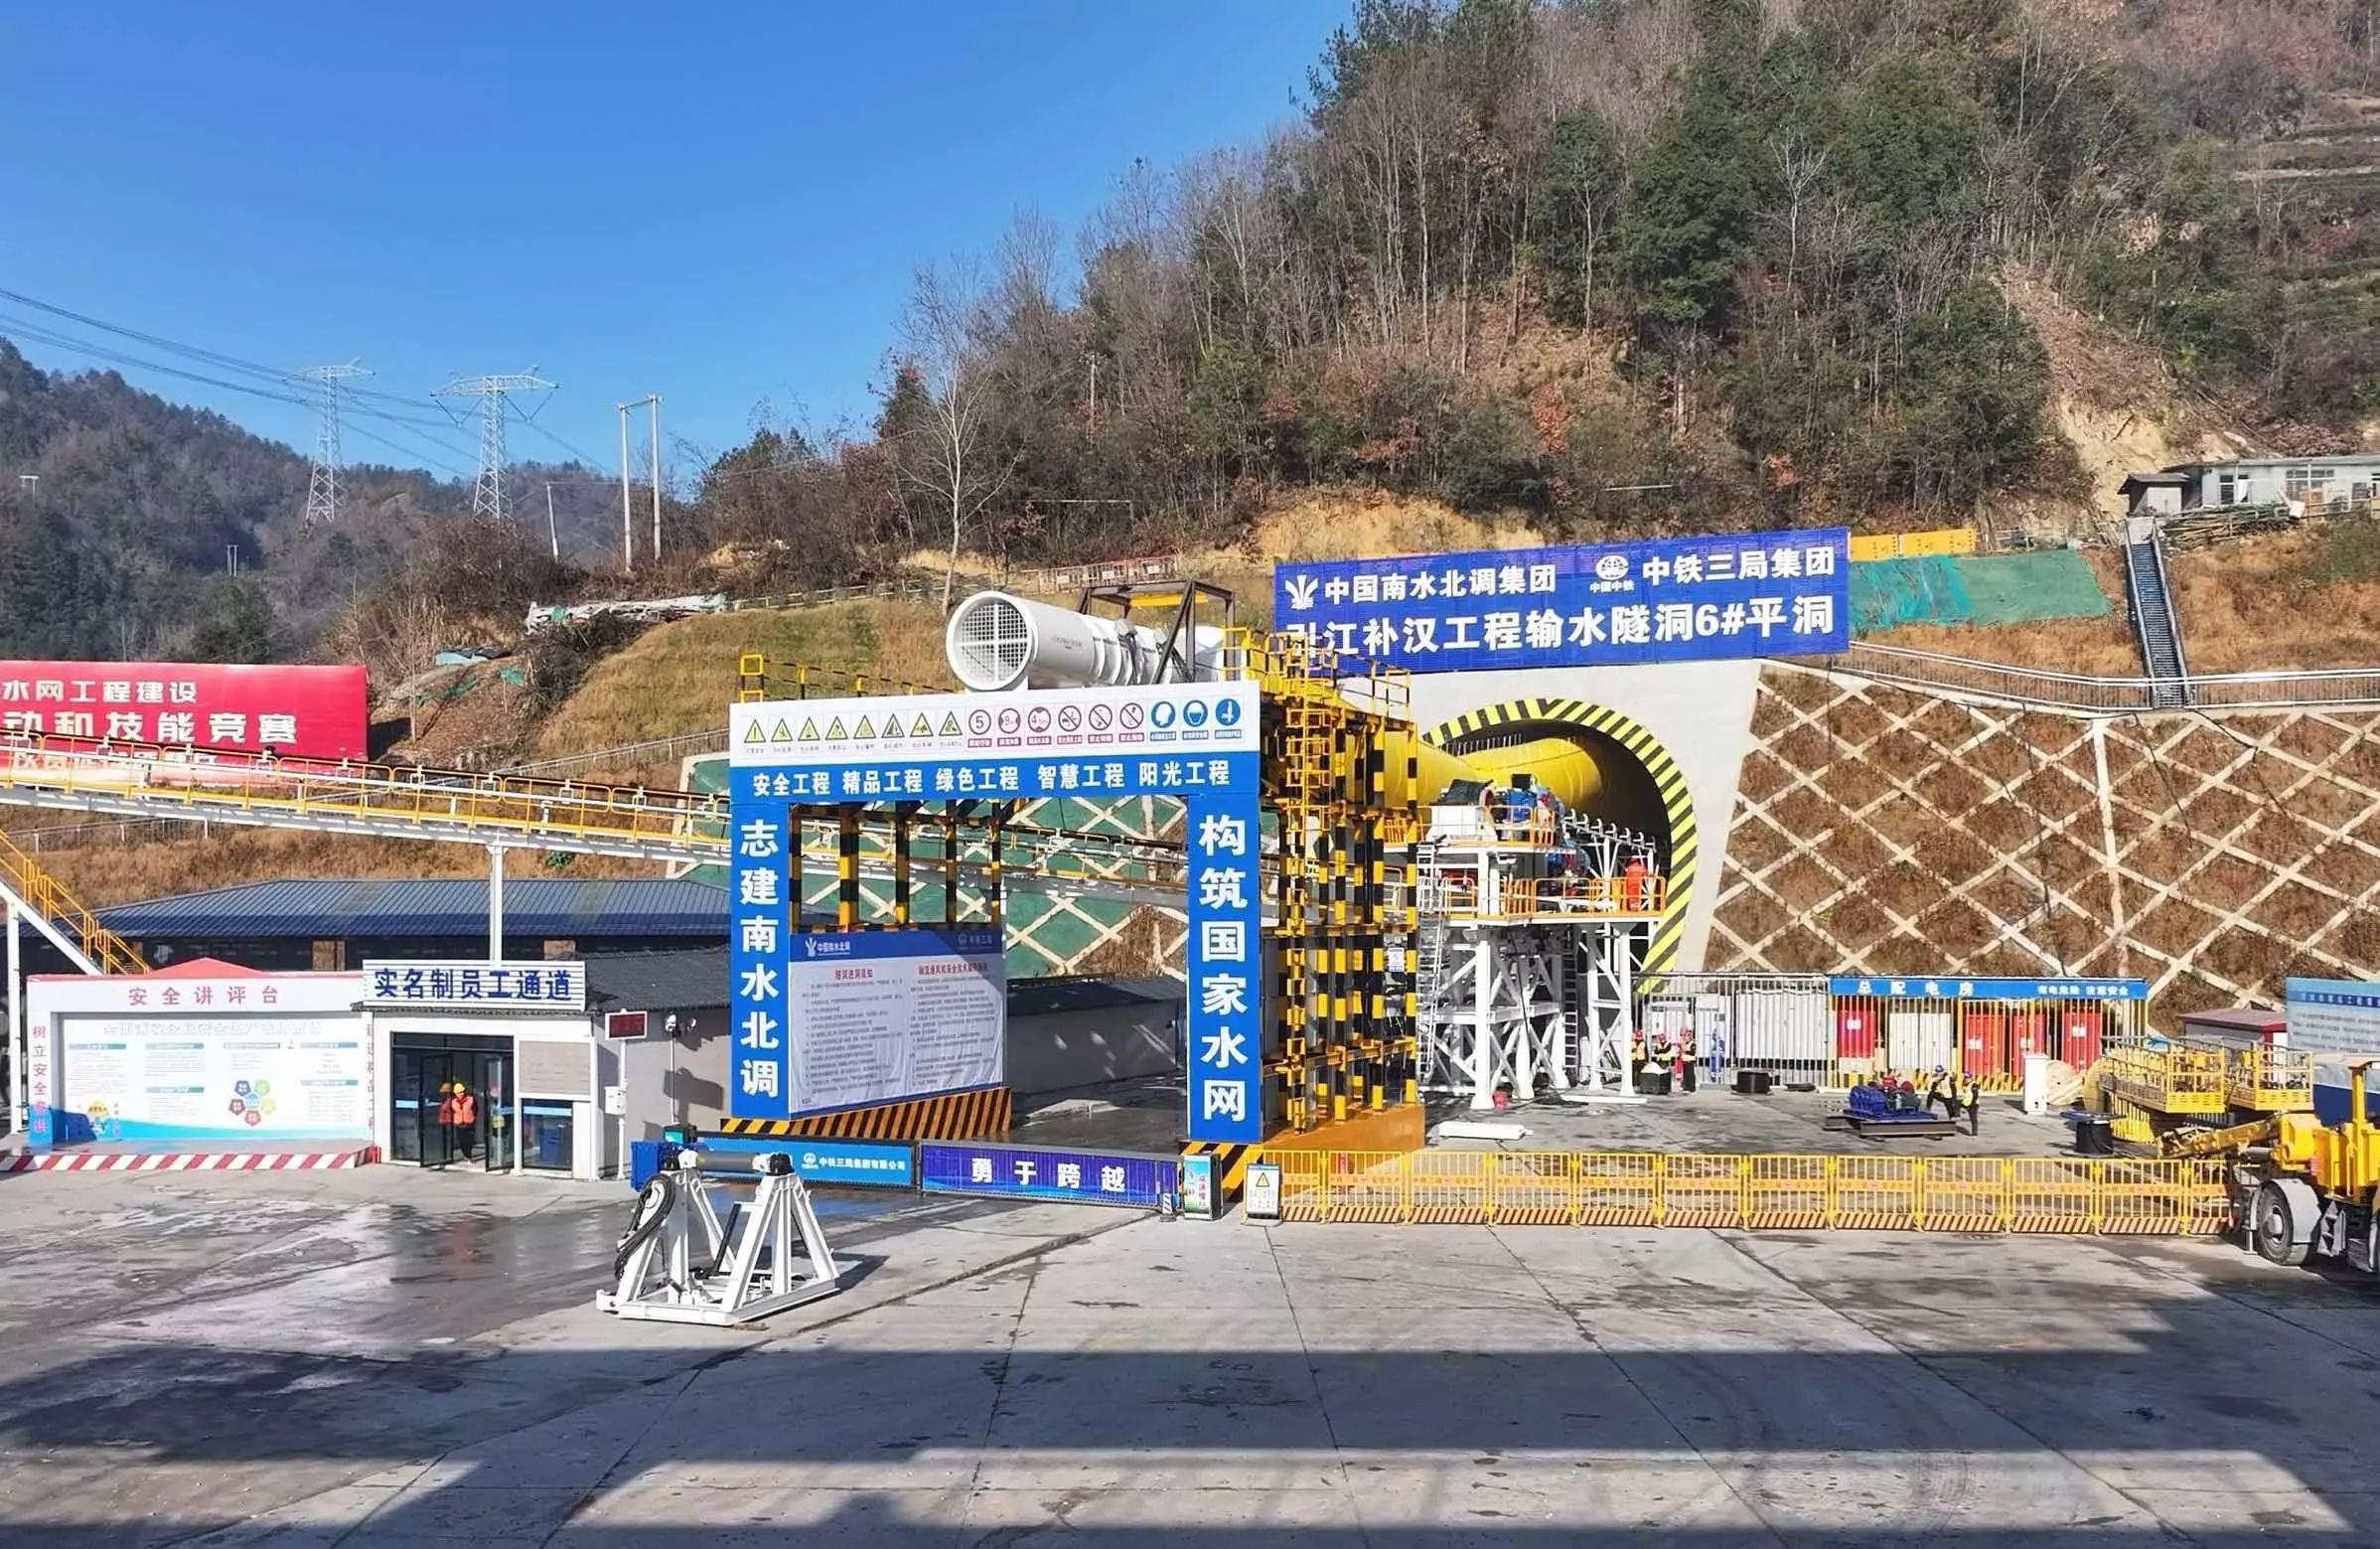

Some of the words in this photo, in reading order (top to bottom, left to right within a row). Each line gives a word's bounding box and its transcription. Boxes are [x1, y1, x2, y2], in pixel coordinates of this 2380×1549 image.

[1324, 562, 1557, 606] 中国南水北调集团
[1642, 545, 1835, 585] 中铁三局集团
[1589, 580, 1635, 593] 中国中铁
[2, 680, 197, 703] 水网工程建设
[975, 715, 983, 728] 5
[752, 771, 830, 796] 安全工程
[842, 769, 923, 793] 精品工程
[936, 766, 1019, 792] 绿色工程
[1038, 761, 1124, 789] 智慧工程
[1138, 758, 1230, 786] 阳光工程
[740, 819, 779, 1098] 志建南水北调
[1199, 814, 1248, 1123] 构筑国家水网
[128, 986, 279, 1006] 安全讲评台
[374, 970, 572, 1001] 实名制员工通道
[1858, 980, 1974, 996] 总配电房
[819, 1157, 906, 1171] 中铁三局集团有限公司
[971, 1158, 1125, 1193] 勇于跨越
